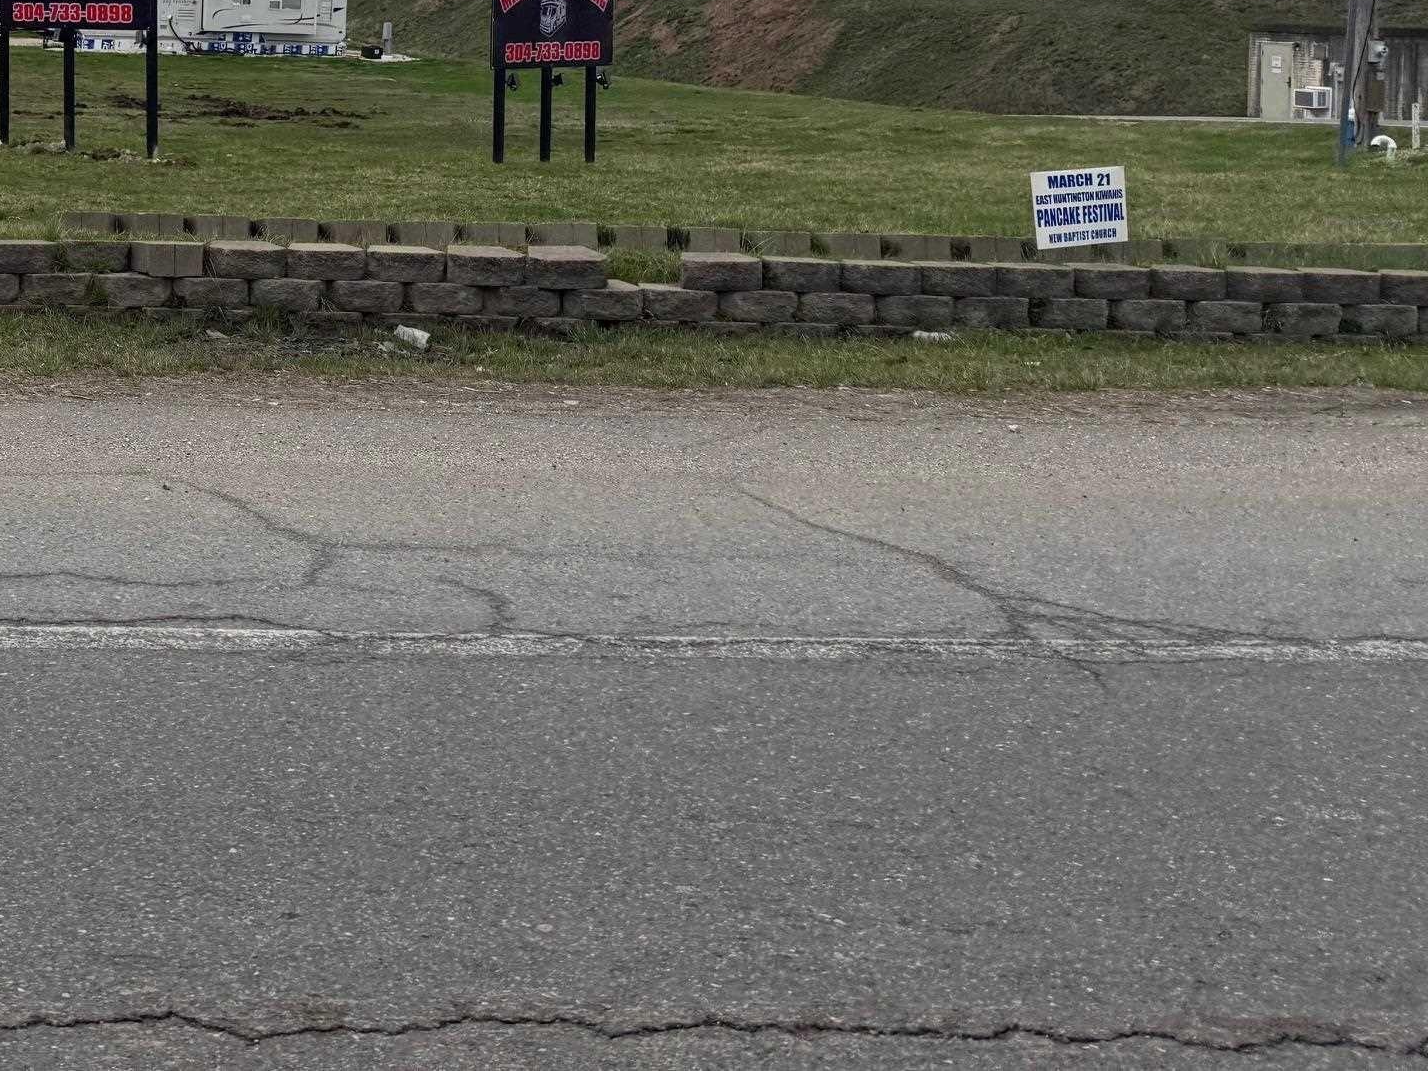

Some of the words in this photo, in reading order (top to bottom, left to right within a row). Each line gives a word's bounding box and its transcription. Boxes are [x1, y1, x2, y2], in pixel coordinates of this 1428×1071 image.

[12, 2, 134, 23] 304-733-0898
[1047, 173, 1093, 189] MARCH
[1097, 172, 1111, 186] 21
[1036, 195, 1052, 205] EAST
[1053, 191, 1094, 203] HUNTINGTON
[1036, 207, 1080, 227] PANCAKE
[1082, 203, 1124, 223] FESTIVAL
[1049, 233, 1062, 243] NEW
[1063, 231, 1090, 242] BAPTIST
[1090, 228, 1117, 240] CHURCH
